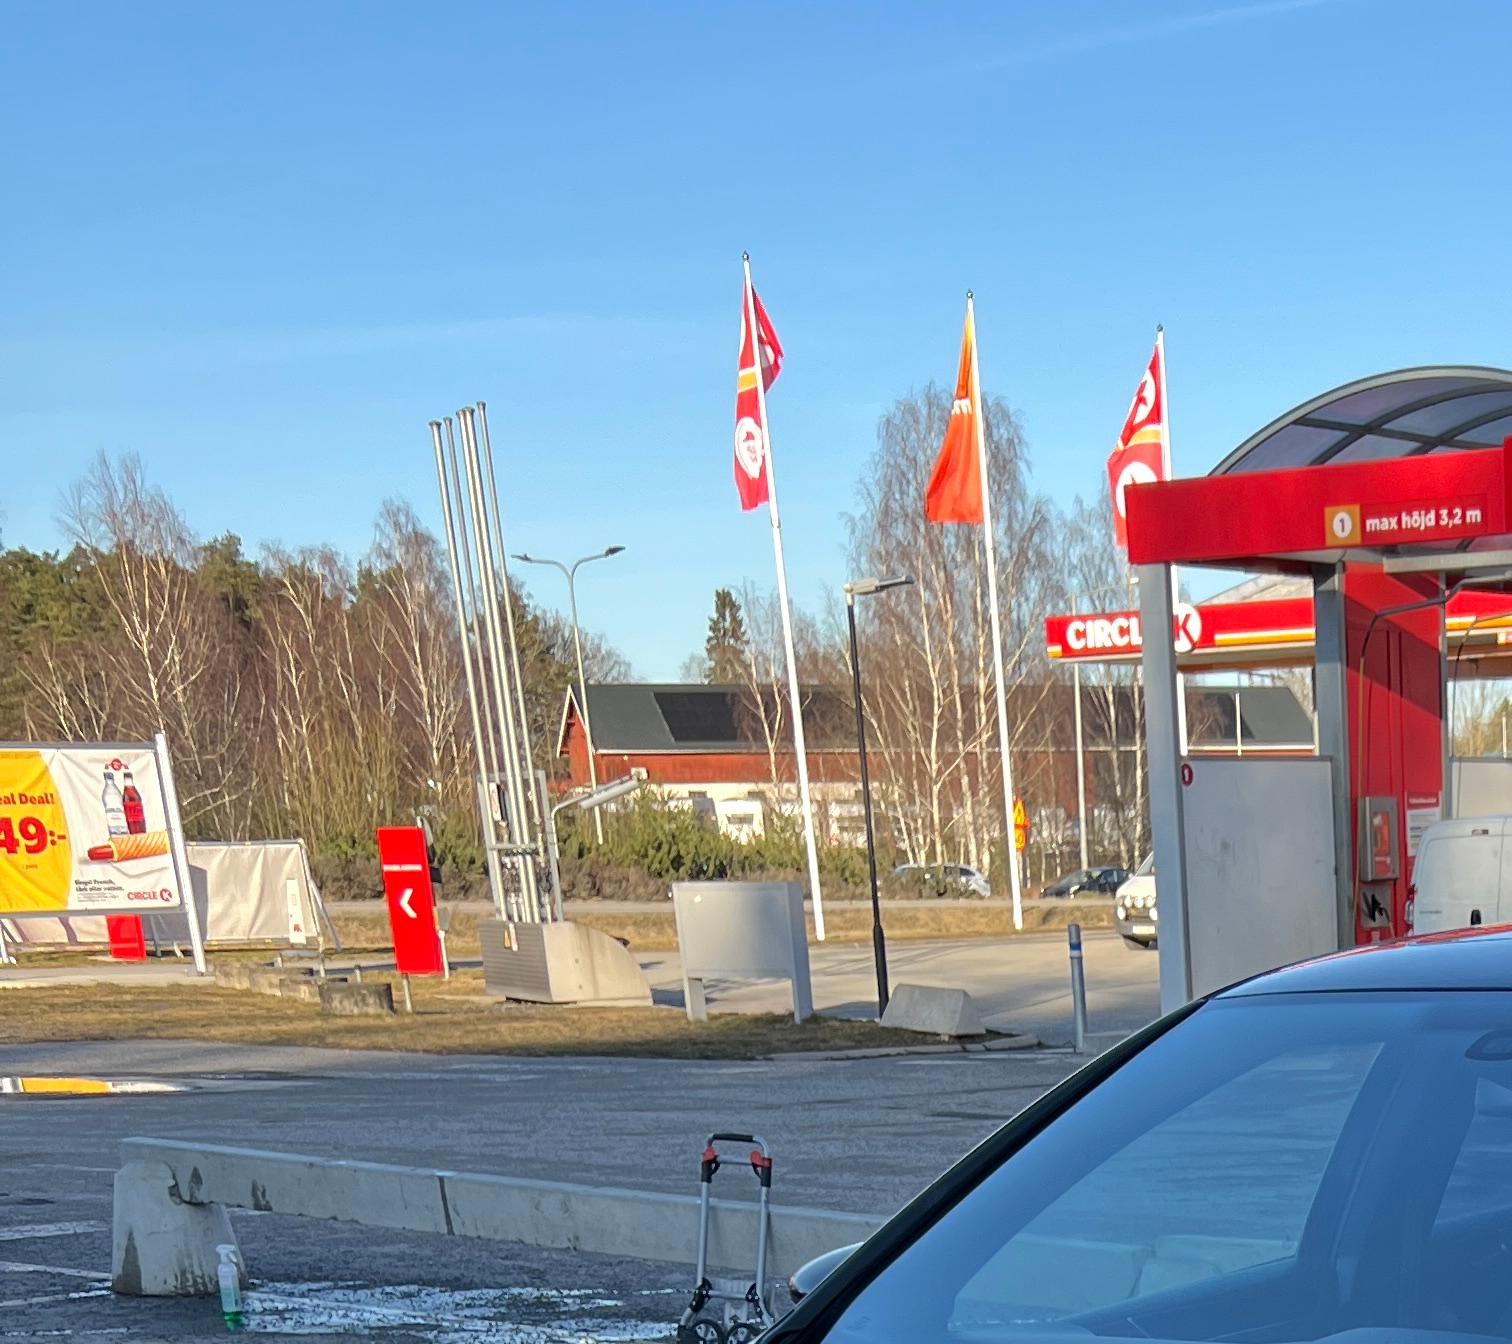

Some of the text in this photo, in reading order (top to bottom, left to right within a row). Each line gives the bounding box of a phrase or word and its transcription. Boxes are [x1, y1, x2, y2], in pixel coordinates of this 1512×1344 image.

[1365, 515, 1398, 532] max
[1401, 509, 1436, 531] höjd
[1439, 508, 1463, 528] 3,2
[1466, 508, 1481, 523] m
[1066, 618, 1143, 650] CIRCL
[18, 792, 55, 805] Deal!
